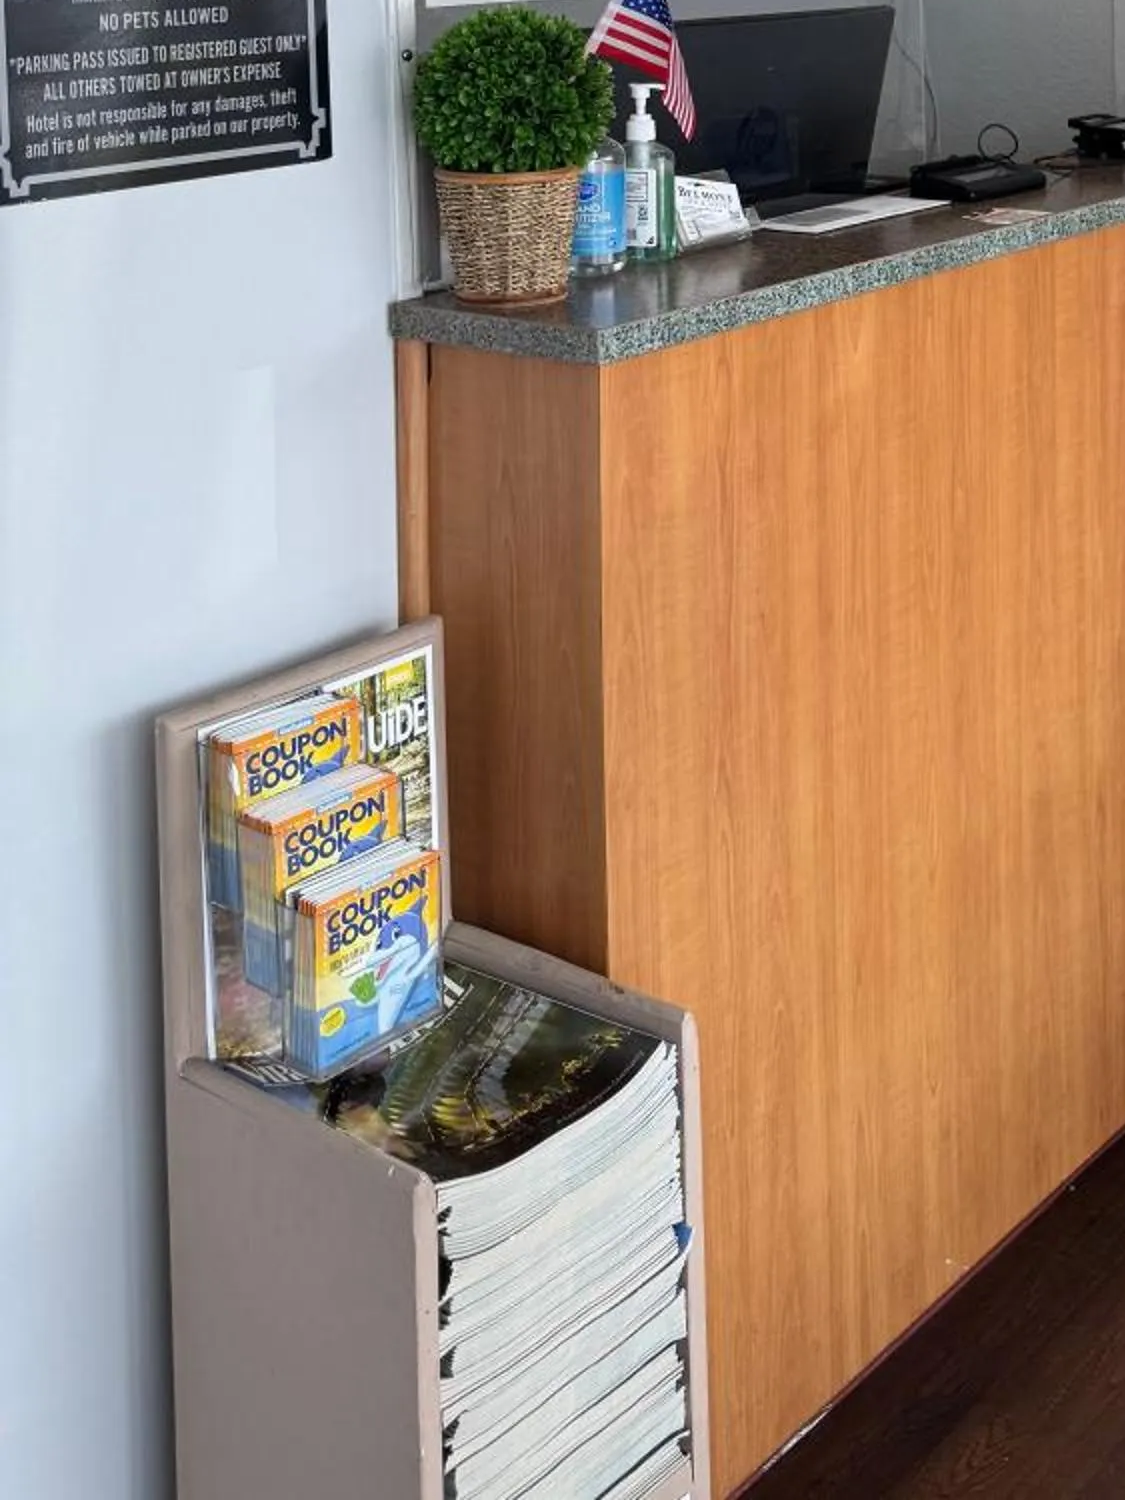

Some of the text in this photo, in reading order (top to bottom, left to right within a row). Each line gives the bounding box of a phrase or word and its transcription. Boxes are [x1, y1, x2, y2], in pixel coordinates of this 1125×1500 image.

[99, 7, 229, 32] NO PETS ALLOWED
[72, 50, 105, 71] PASS
[107, 47, 149, 68] ISSUED
[152, 46, 167, 64] TO
[169, 41, 237, 62] REGISTERED
[239, 36, 273, 57] GUEST
[43, 61, 282, 102] ALL OTHERS TOWED AT OWNER'S EXPENSE
[26, 113, 60, 133] Hotel
[62, 112, 73, 128] is
[76, 109, 97, 129] not
[100, 102, 167, 126] responsible
[171, 99, 187, 117] for
[191, 97, 211, 118] any
[271, 88, 297, 105] theft
[25, 139, 49, 159] and
[52, 136, 74, 155] fire
[77, 134, 90, 151] of
[94, 129, 135, 150] vehicle
[138, 124, 169, 145] while
[171, 120, 211, 145] parked
[214, 120, 227, 135] on
[229, 118, 248, 134] our
[246, 716, 347, 775] COUPON
[249, 750, 315, 797] BOOK
[284, 792, 386, 854] COUPON
[287, 827, 353, 877] BOOK
[327, 868, 428, 935] COUPON
[328, 904, 394, 956] BOOK
